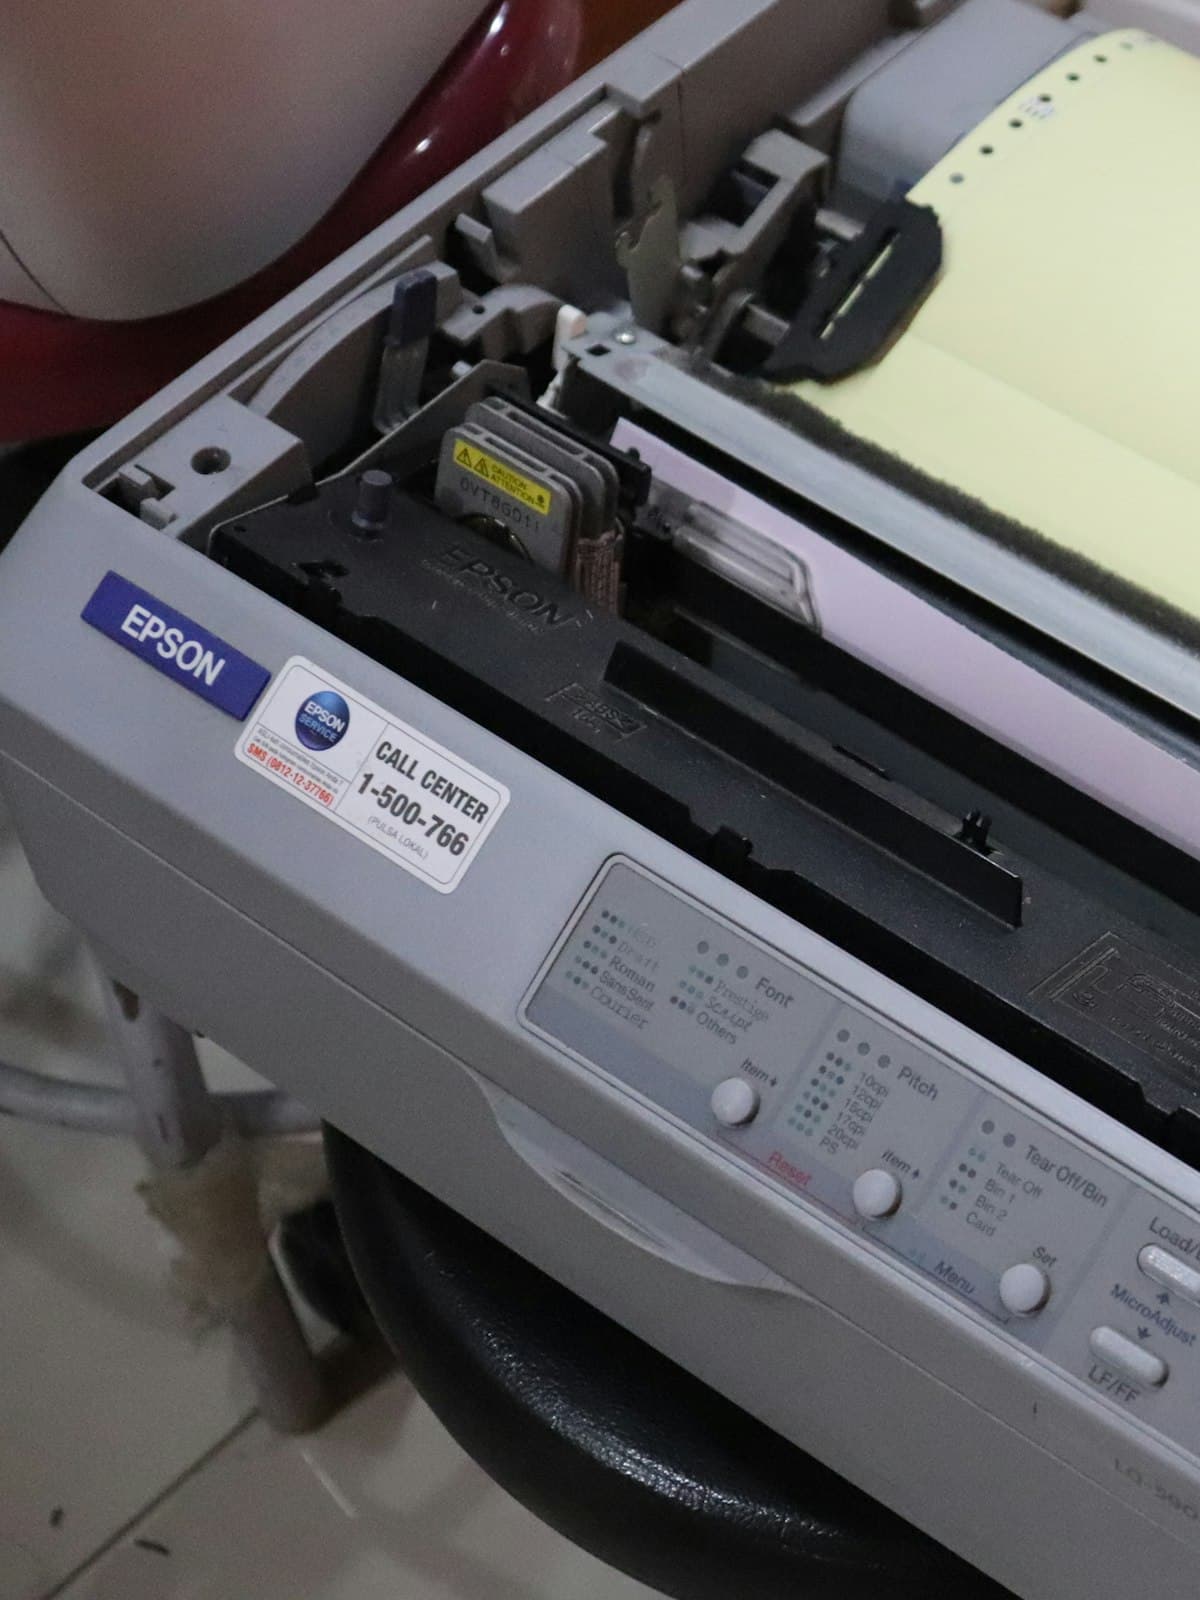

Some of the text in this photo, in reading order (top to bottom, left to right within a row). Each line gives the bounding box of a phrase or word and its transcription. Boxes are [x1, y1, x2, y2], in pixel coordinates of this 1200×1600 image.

[120, 603, 227, 687] EPSON
[298, 713, 339, 743] SERVICE
[303, 699, 346, 733] EPSON
[246, 742, 268, 766] SMS
[374, 740, 417, 781] CALL
[419, 769, 491, 825] CENTER
[355, 772, 470, 857] 1-500-766
[608, 955, 657, 993] Roman
[589, 985, 650, 1031] Courier
[712, 980, 770, 1023] Prestige
[755, 976, 794, 1009] Font
[696, 1010, 738, 1045] Others
[741, 1058, 770, 1083] Item
[859, 1071, 889, 1099] 10cpi
[897, 1064, 939, 1101] Pitch
[852, 1084, 882, 1111] 12cpi
[827, 1123, 860, 1152] 20cpi
[767, 1150, 813, 1188] Reset
[881, 1149, 912, 1177] Item
[1025, 1143, 1109, 1209] Tear Off/Bin
[984, 1177, 1007, 1199] Bin
[996, 1164, 1044, 1199] Tear Off
[965, 1210, 997, 1239] Card
[975, 1193, 1009, 1222] Bin 2
[1032, 1245, 1059, 1268] Set
[933, 1259, 977, 1296] Menu
[1087, 1364, 1142, 1404] LF/FF
